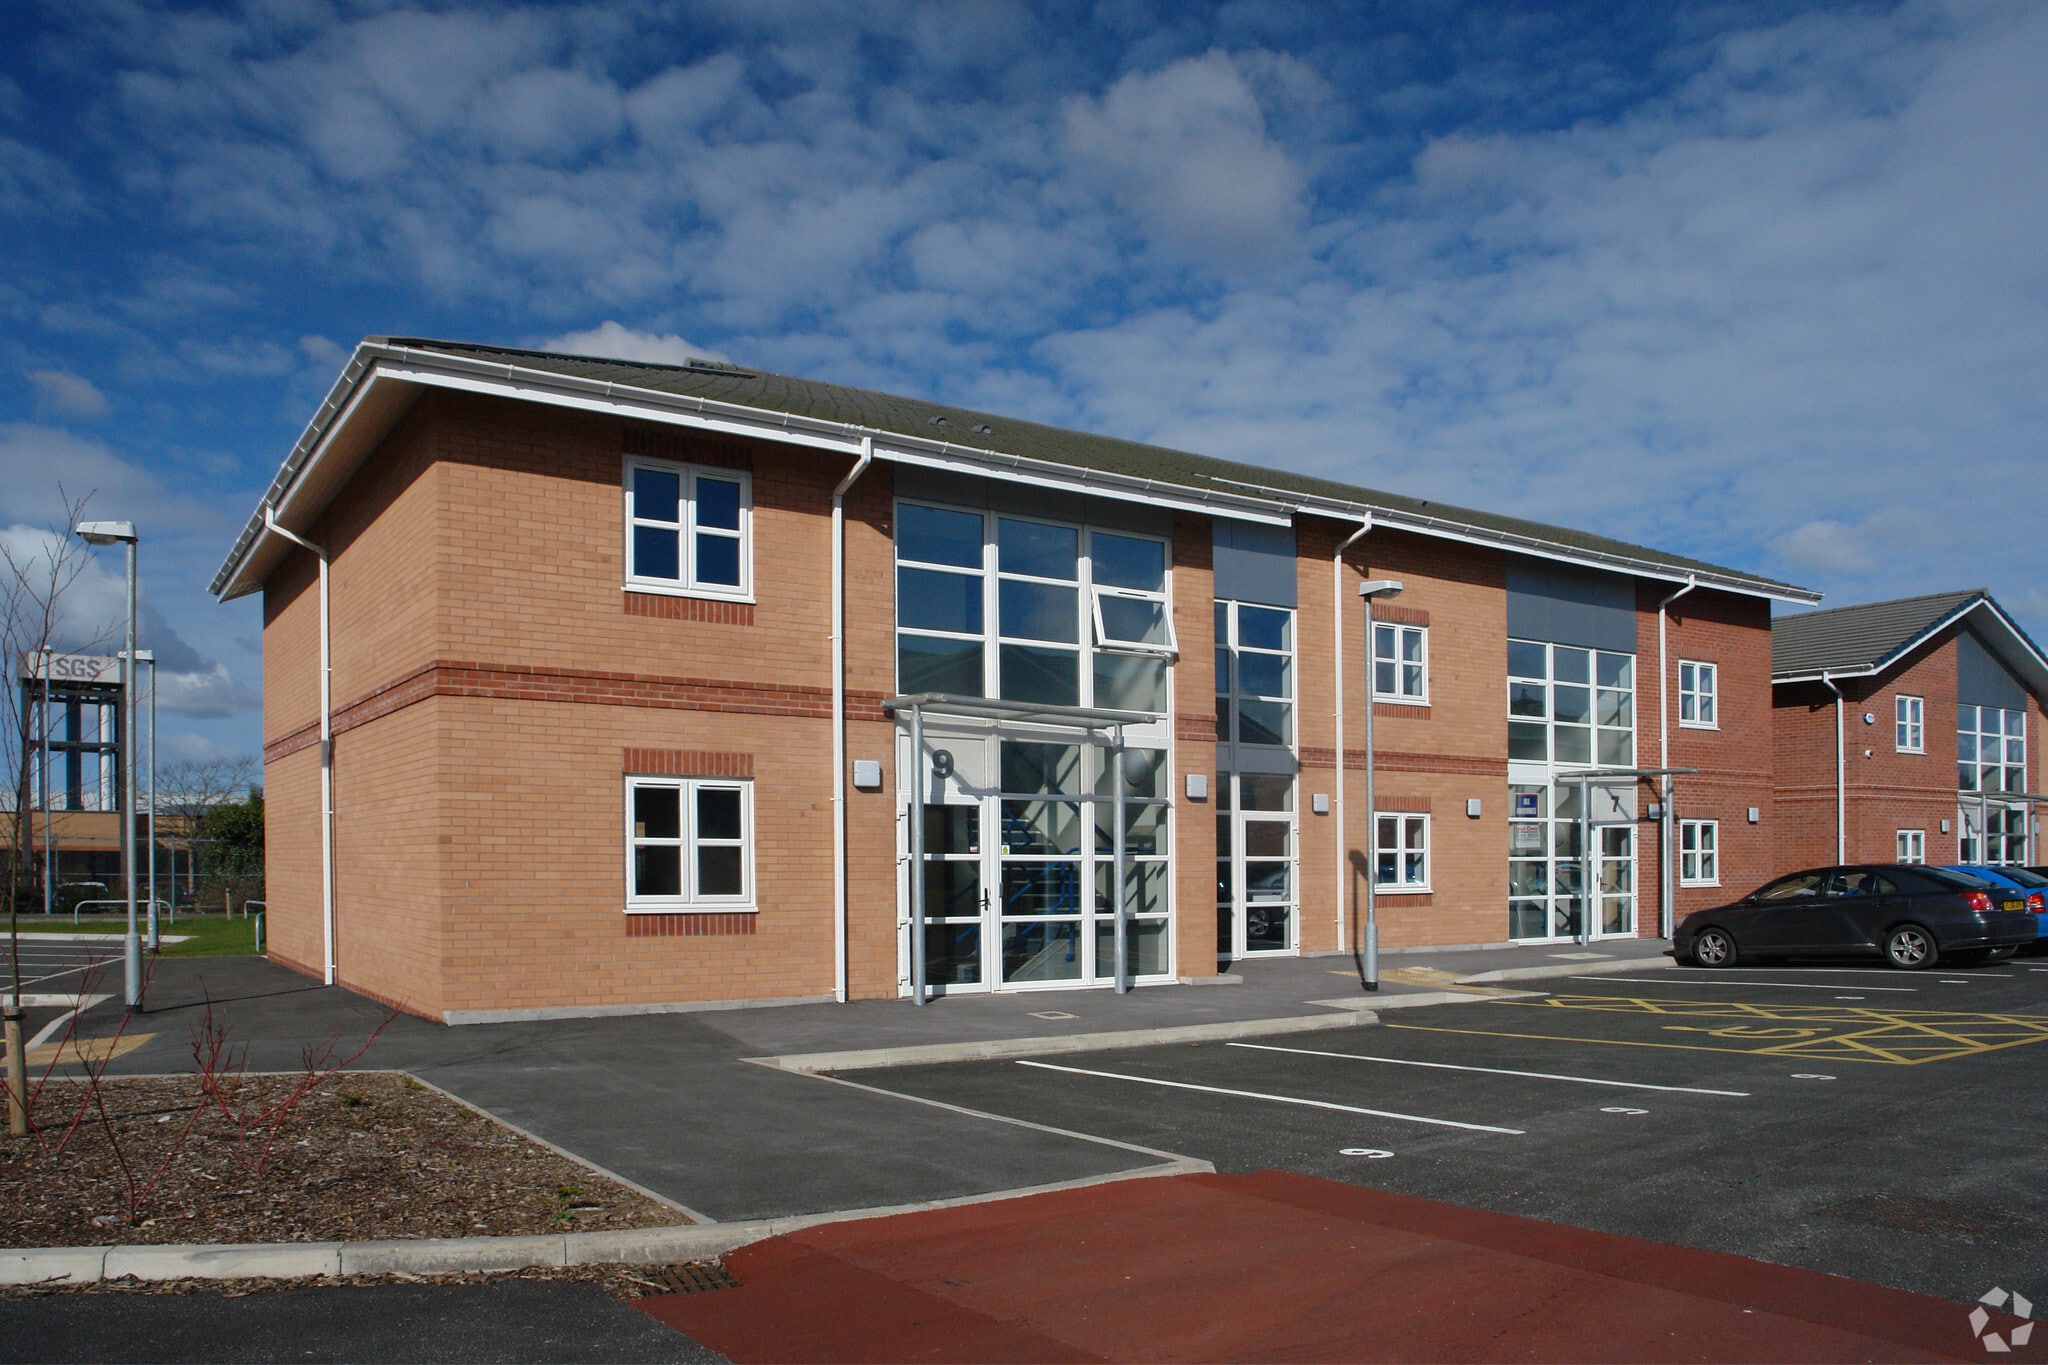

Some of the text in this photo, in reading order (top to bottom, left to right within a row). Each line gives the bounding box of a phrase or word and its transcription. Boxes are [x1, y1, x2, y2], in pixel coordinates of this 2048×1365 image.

[56, 657, 101, 678] SGS
[932, 749, 955, 779] 9
[1610, 795, 1620, 812] 7
